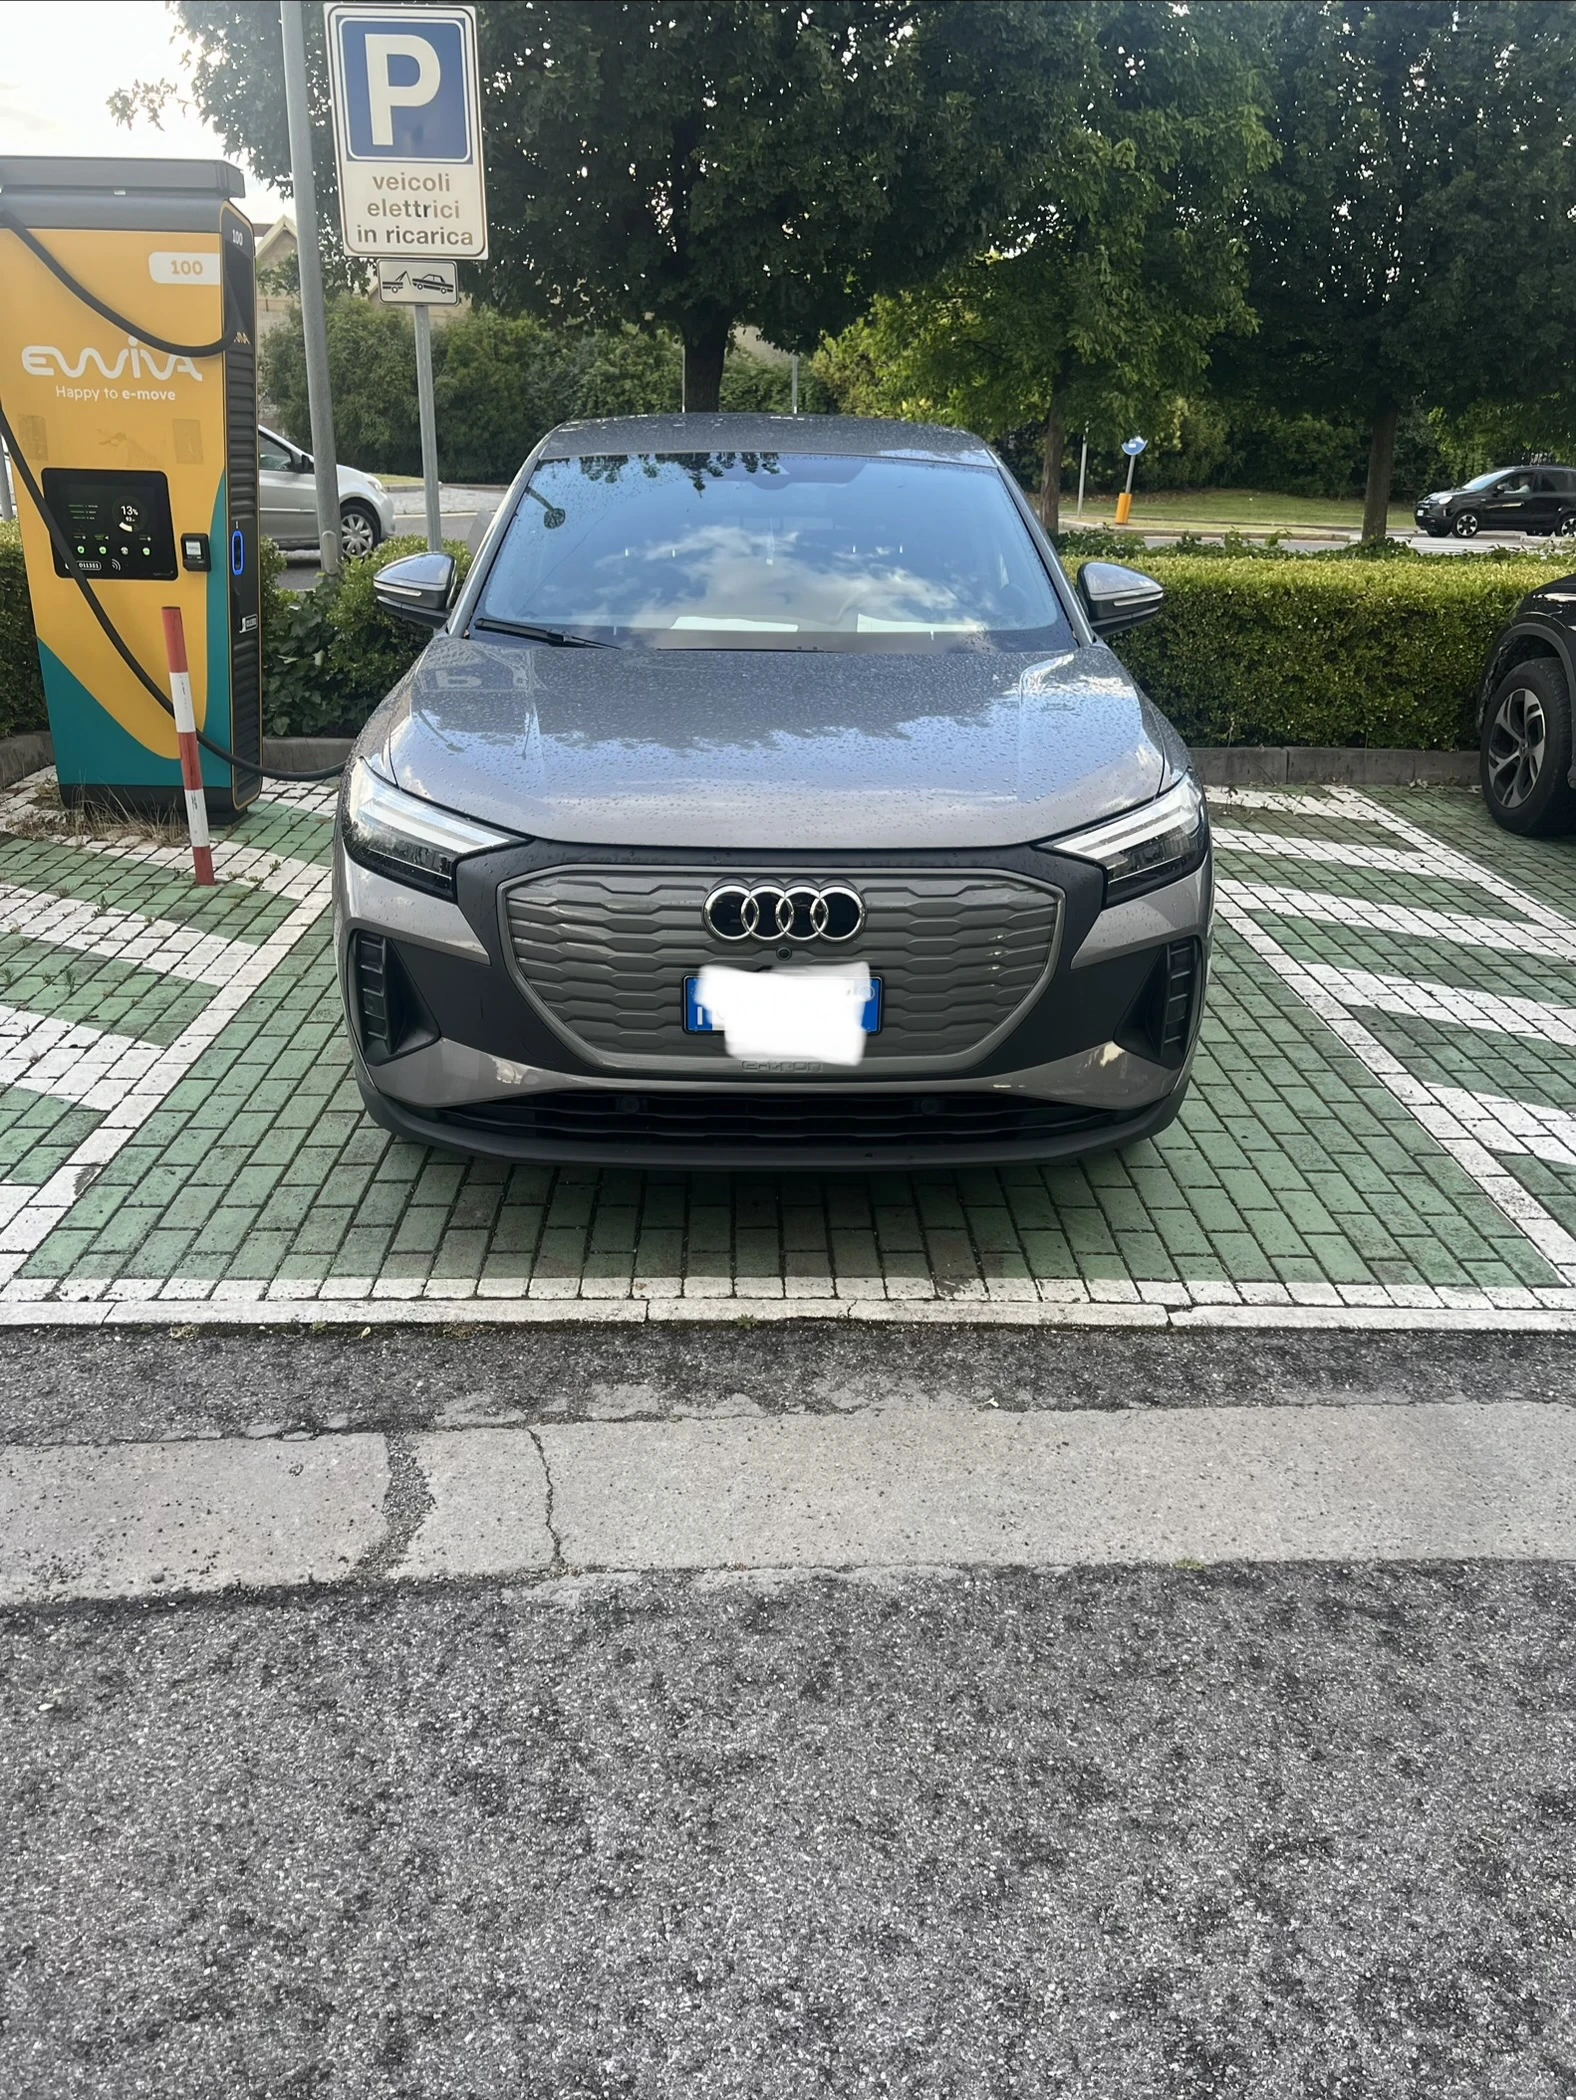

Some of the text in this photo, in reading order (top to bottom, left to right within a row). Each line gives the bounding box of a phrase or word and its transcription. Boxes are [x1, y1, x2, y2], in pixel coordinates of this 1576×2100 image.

[364, 33, 441, 146] P
[372, 172, 450, 192] veicoli
[367, 199, 460, 219] elettrici
[232, 229, 243, 246] 100
[356, 225, 474, 246] in ricarica
[171, 260, 203, 275] 100
[55, 386, 176, 402] Happy to e-move
